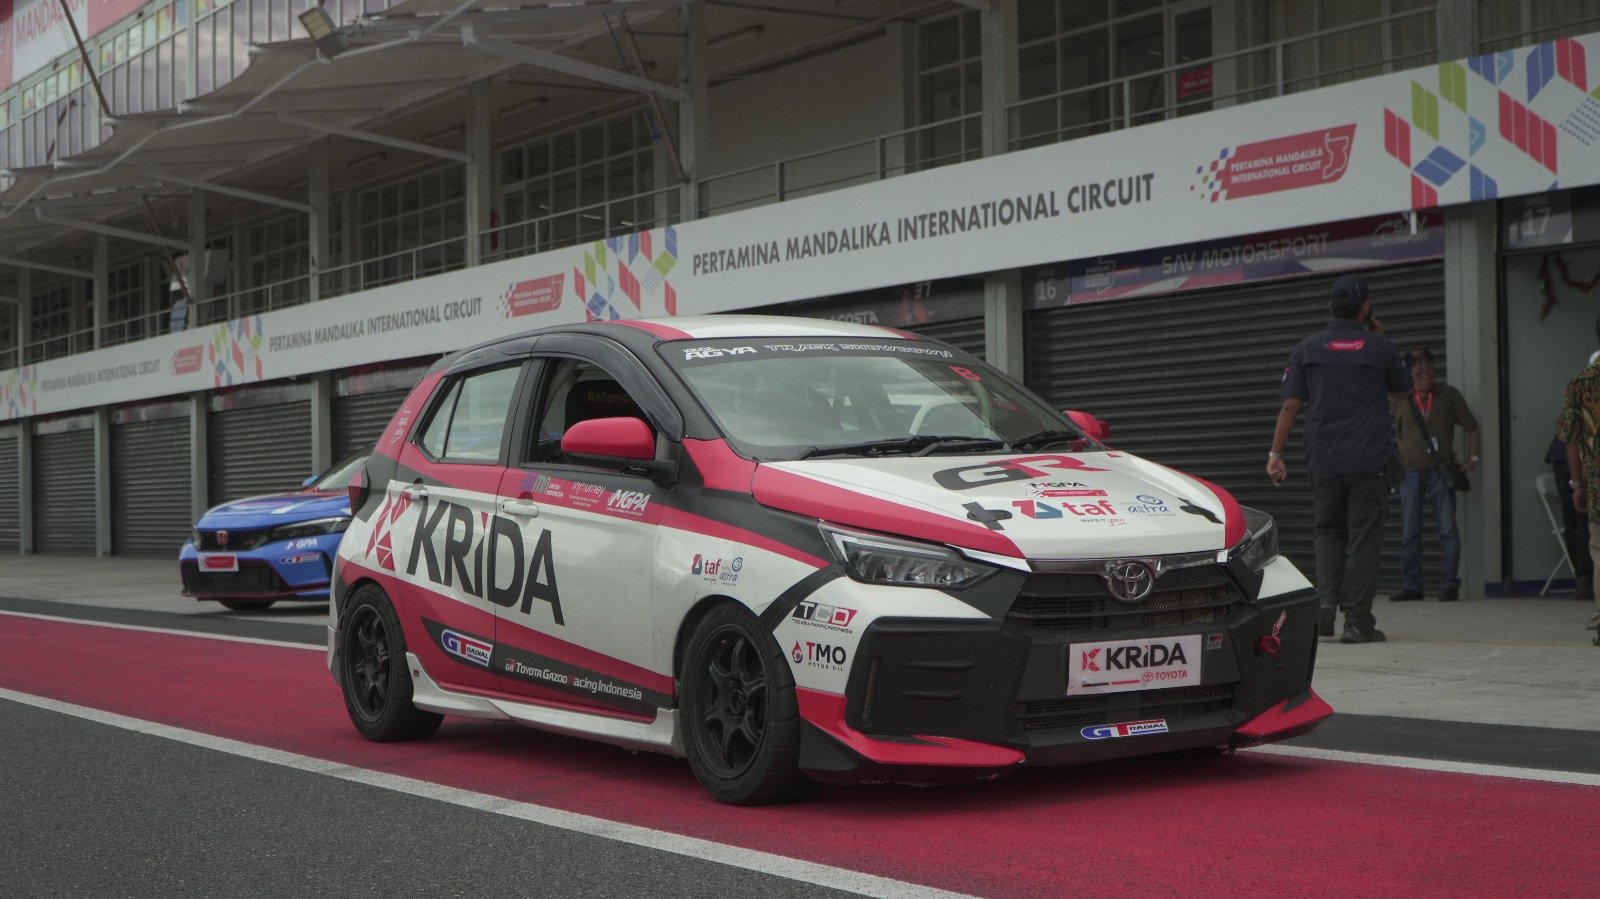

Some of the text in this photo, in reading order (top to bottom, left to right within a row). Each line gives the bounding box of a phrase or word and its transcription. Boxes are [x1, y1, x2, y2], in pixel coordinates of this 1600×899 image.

[1231, 147, 1323, 172] PERTAMINA MANDALIKA
[1231, 160, 1321, 184] INTERNATIONAL CIRCUIT
[693, 173, 1154, 276] PERTAMINA MANDALIKA INTERNATIONAL CIRCUIT
[1522, 207, 1552, 236] 17
[1162, 232, 1329, 274] SAV MOTORSPORT
[1038, 277, 1057, 300] 16
[269, 297, 482, 353] PERTAMINA MANDALIKA INTERNATIONAL CIRCUIT
[685, 346, 758, 361] AGYA
[949, 365, 982, 382] B
[933, 455, 1112, 490] GR
[608, 489, 651, 512] MGPA
[1062, 500, 1117, 516] taf
[1128, 503, 1170, 514] astra
[705, 558, 722, 575] taf
[467, 646, 489, 660] RADIAL
[806, 641, 847, 665] TMO
[808, 662, 829, 670] MOTOR
[1155, 670, 1188, 681] TOYOTA
[599, 680, 642, 701] Indonesia
[1082, 721, 1165, 739] GT RADIAL
